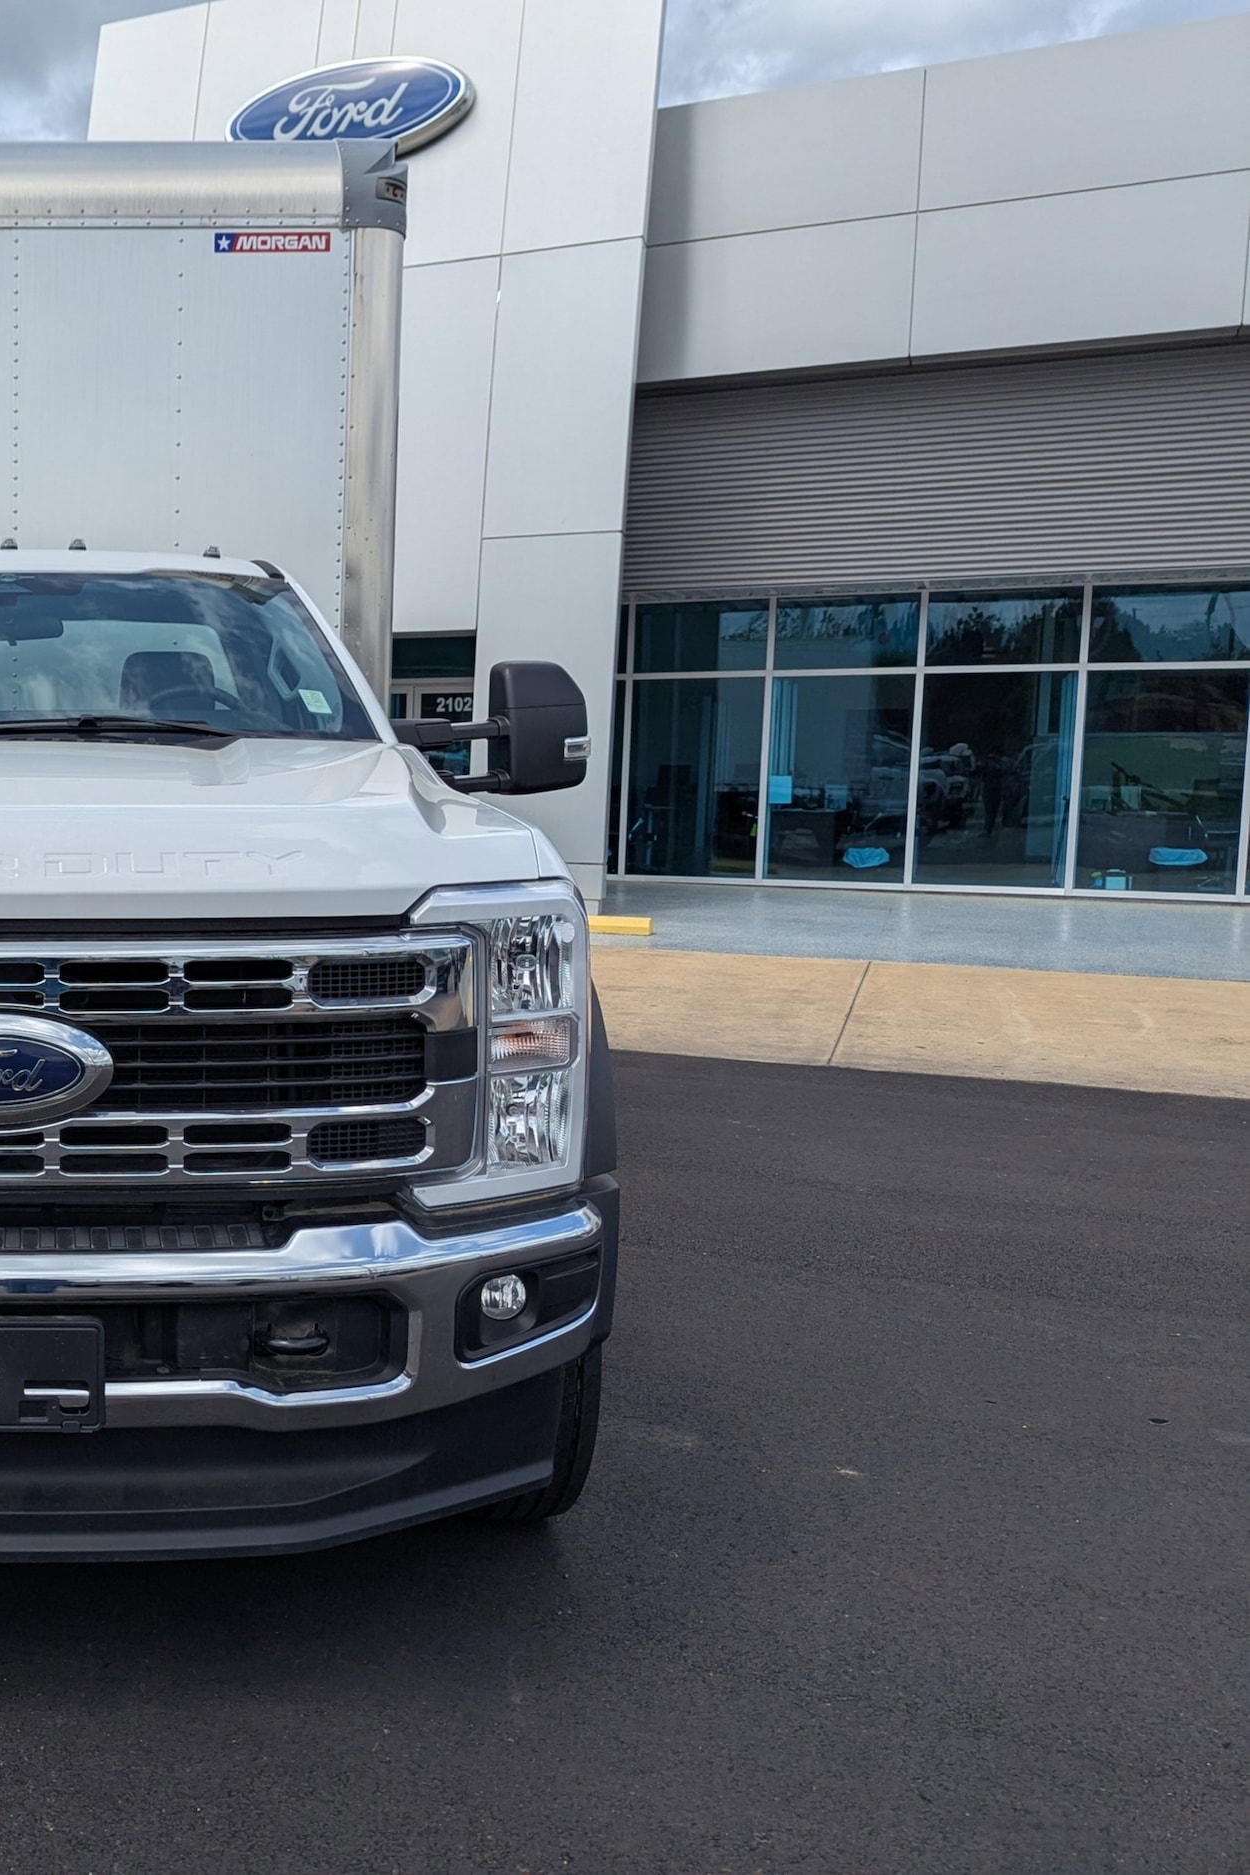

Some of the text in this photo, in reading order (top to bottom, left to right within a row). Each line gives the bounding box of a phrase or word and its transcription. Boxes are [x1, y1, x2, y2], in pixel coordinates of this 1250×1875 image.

[273, 77, 408, 140] Ford
[235, 235, 327, 250] MORGAN
[435, 696, 473, 713] 2102
[44, 850, 303, 878] DUTY
